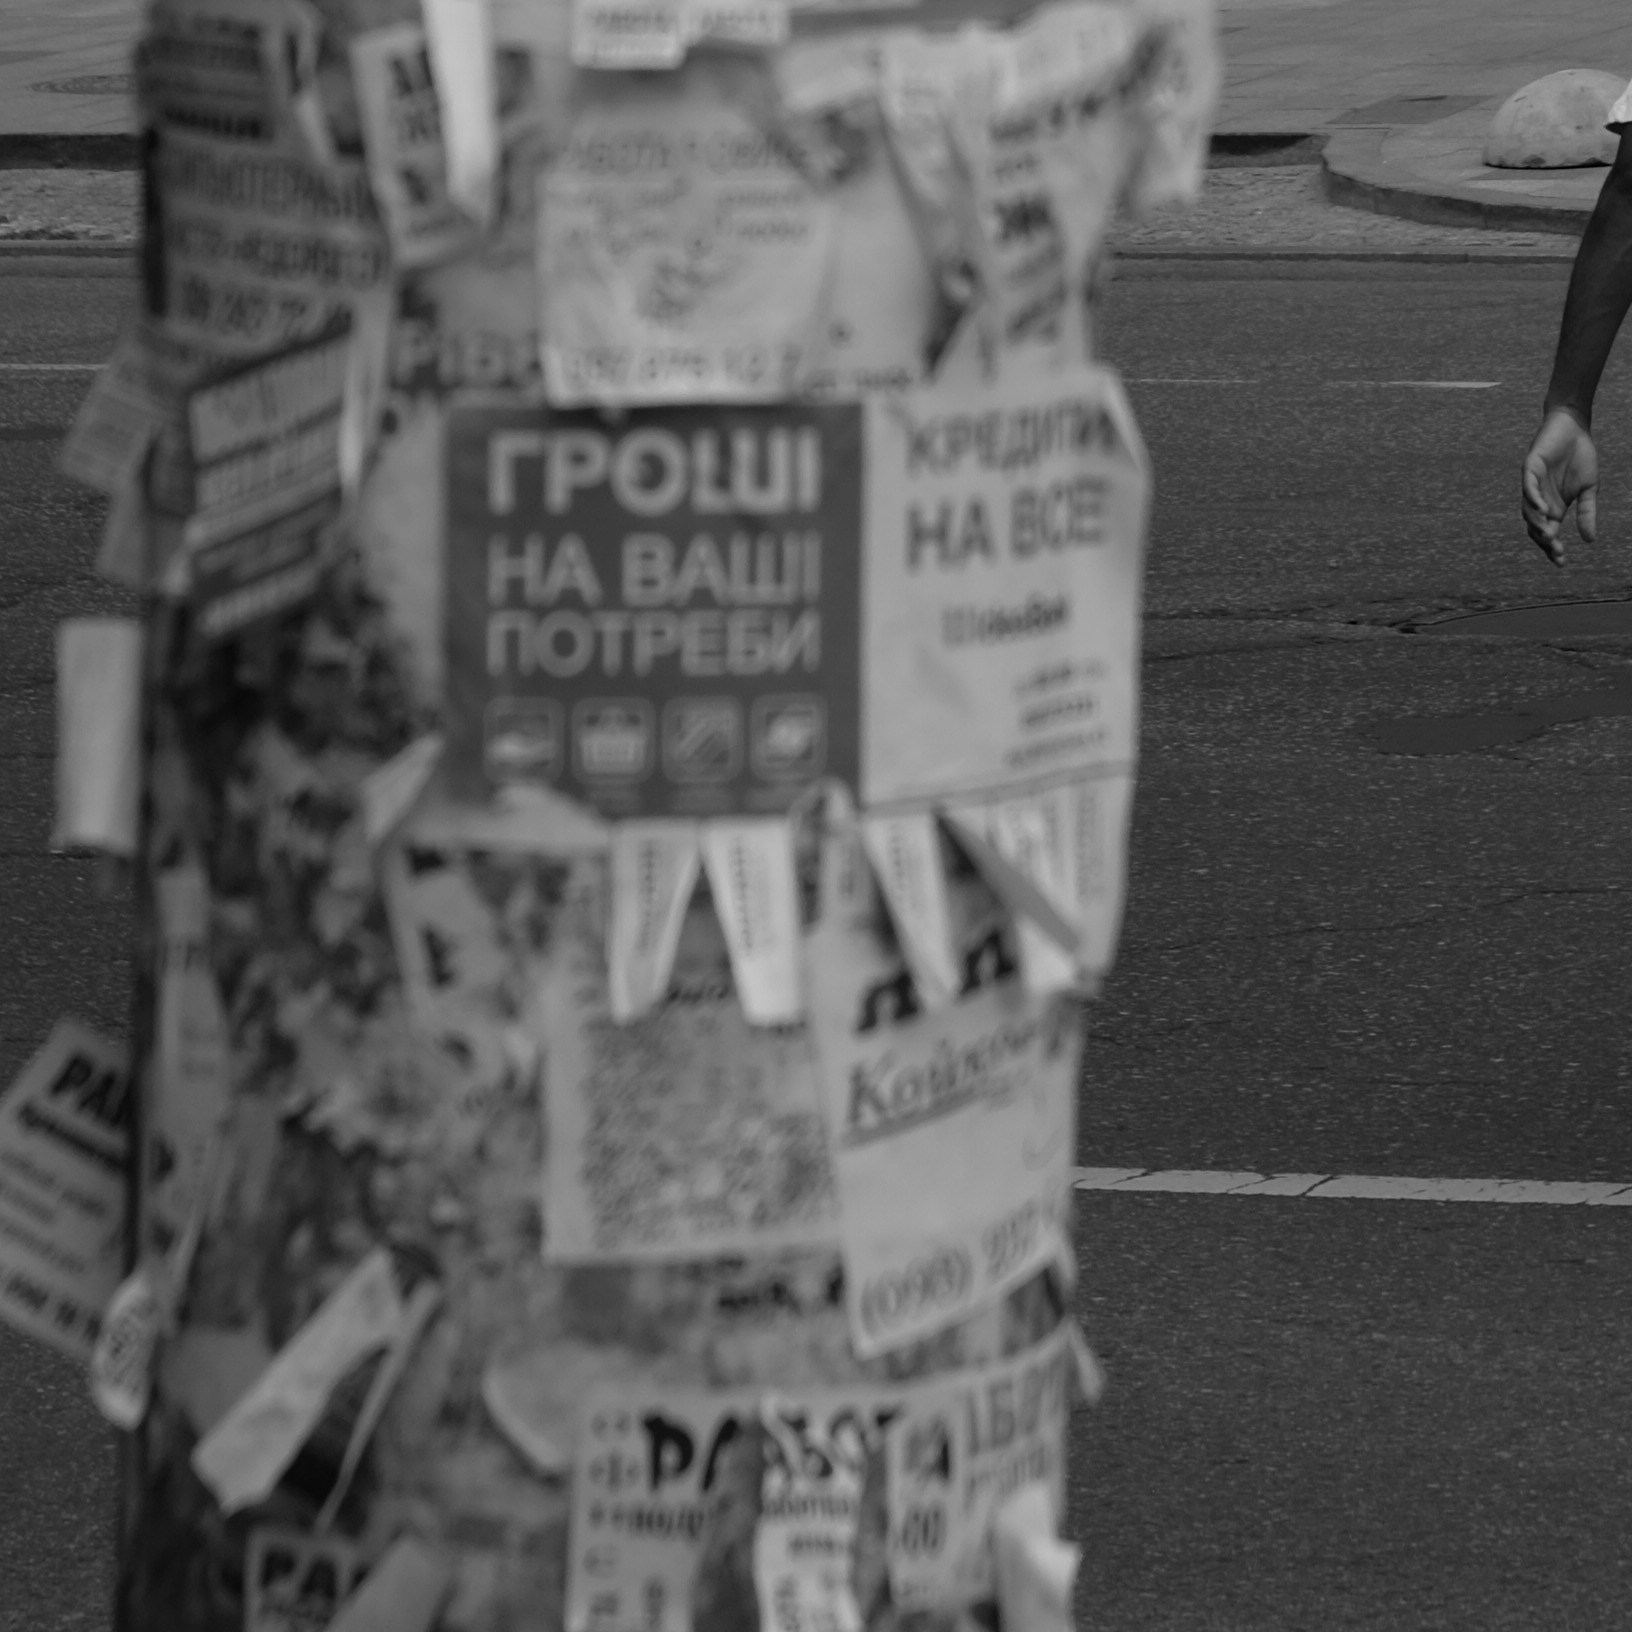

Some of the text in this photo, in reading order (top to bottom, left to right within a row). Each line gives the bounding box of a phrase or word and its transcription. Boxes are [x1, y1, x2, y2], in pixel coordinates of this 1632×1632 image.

[488, 428, 820, 516] ГРОШІ
[906, 478, 1110, 574] НА ВСЕ
[488, 536, 822, 606] НА ВАШІ
[488, 612, 820, 676] ПОТРЕБИ
